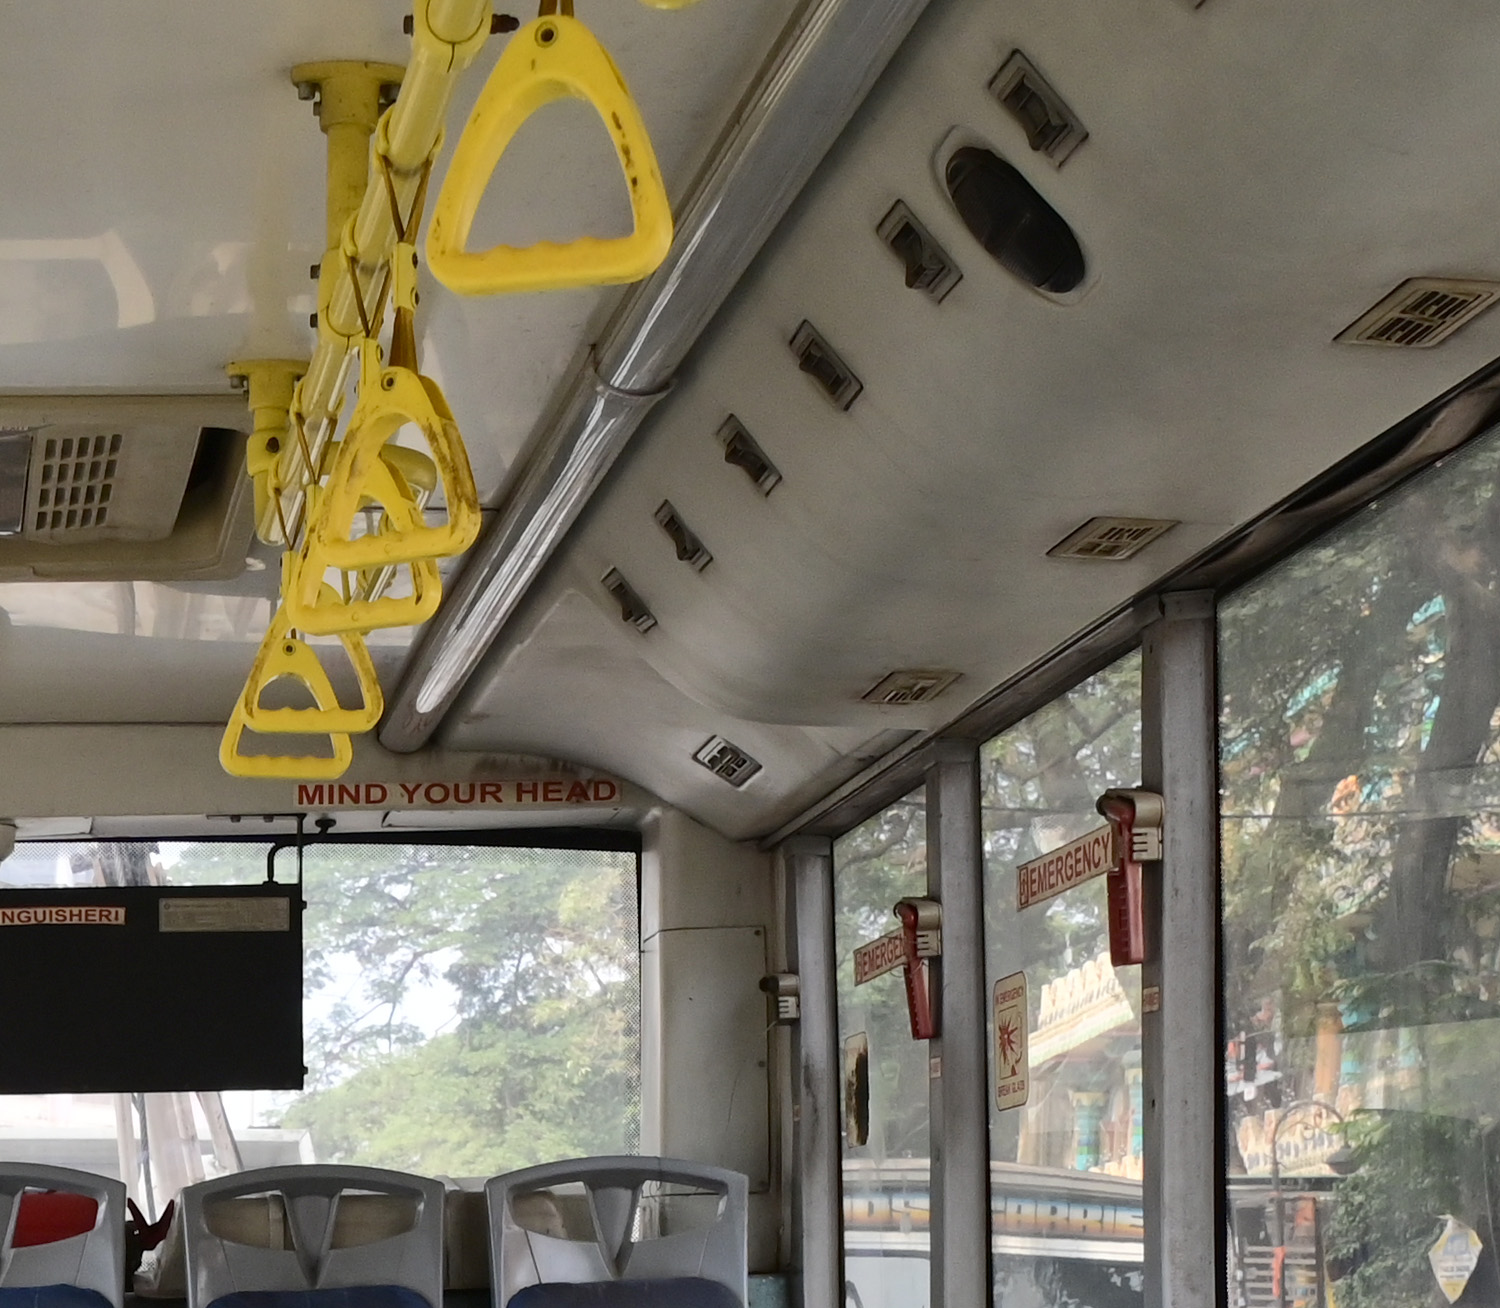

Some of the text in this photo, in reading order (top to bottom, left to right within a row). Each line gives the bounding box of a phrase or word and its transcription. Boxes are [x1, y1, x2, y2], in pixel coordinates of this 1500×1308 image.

[297, 780, 616, 805] MIND YOUR HEAD
[1029, 831, 1110, 898] EMERGENCY
[863, 935, 903, 977] EMERGE
